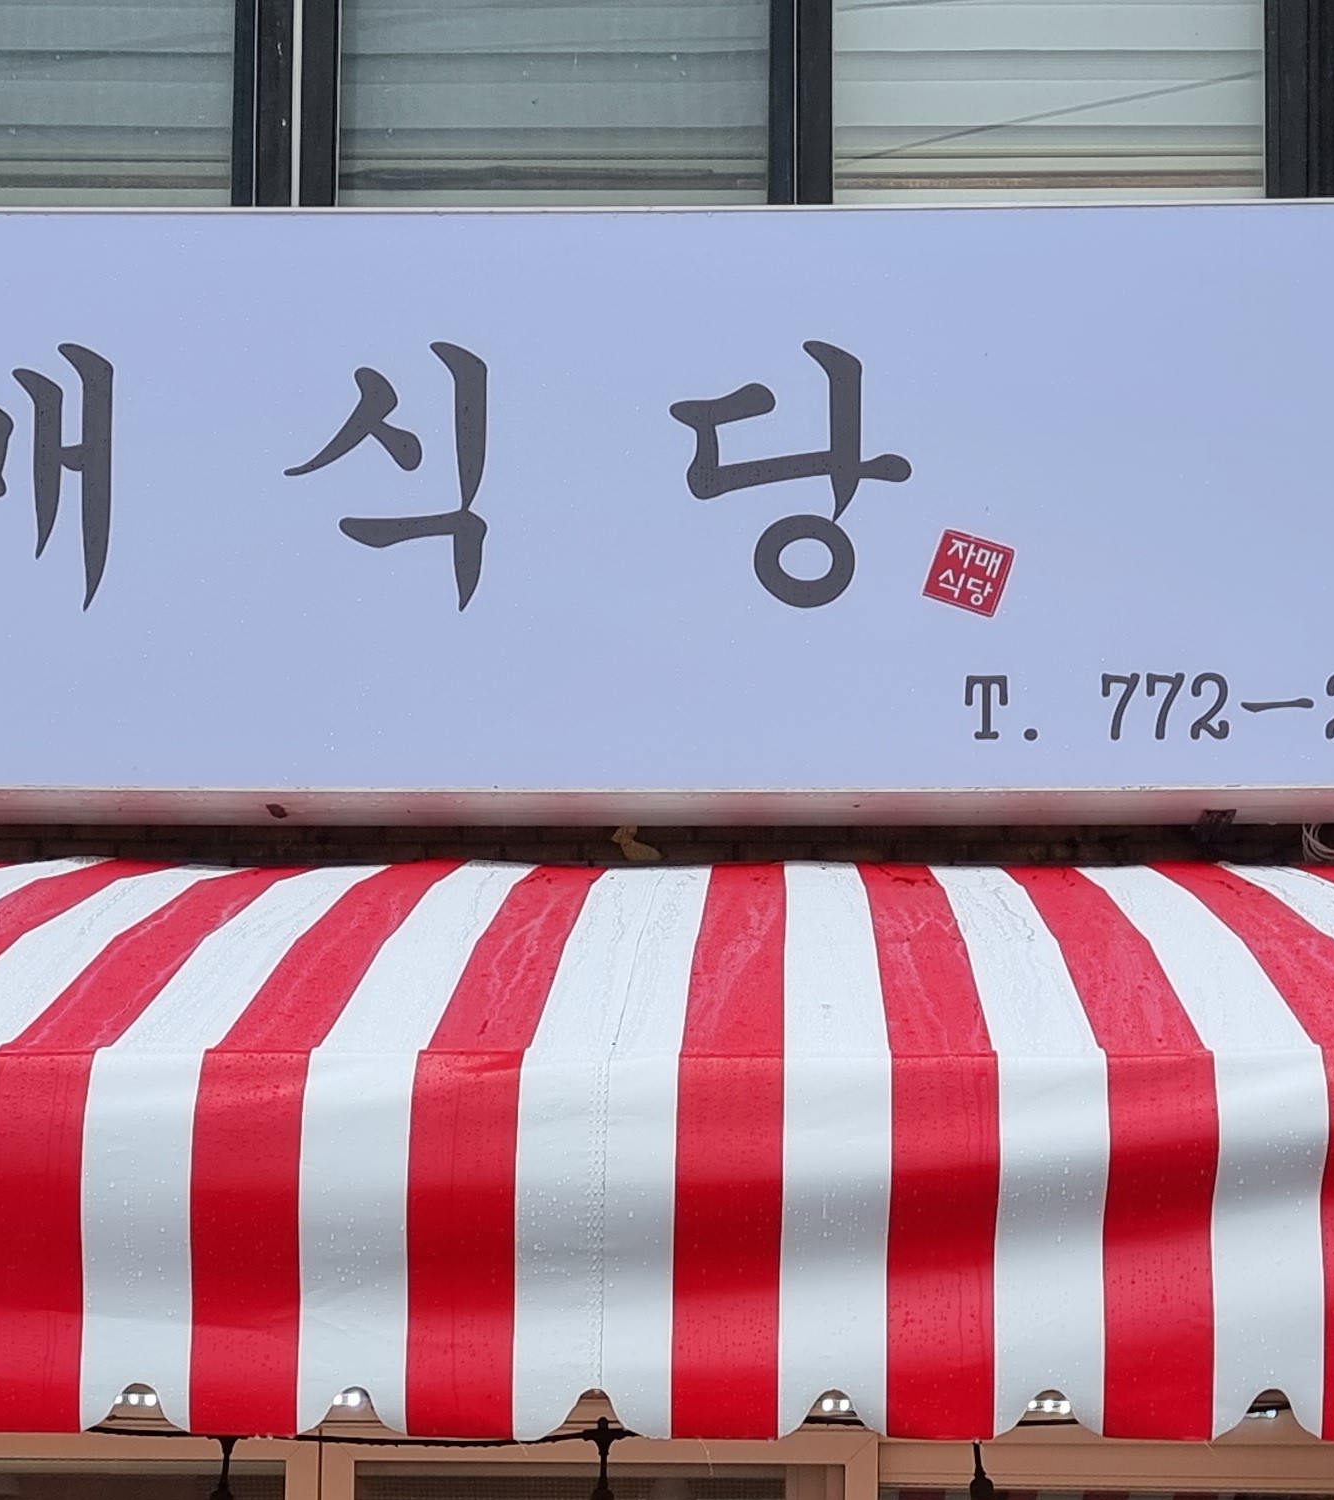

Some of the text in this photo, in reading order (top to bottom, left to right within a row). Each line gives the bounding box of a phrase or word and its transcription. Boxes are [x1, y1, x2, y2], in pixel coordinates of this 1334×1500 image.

[946, 538, 1004, 579] 자매
[937, 568, 994, 606] 식당
[964, 674, 1039, 740] T.
